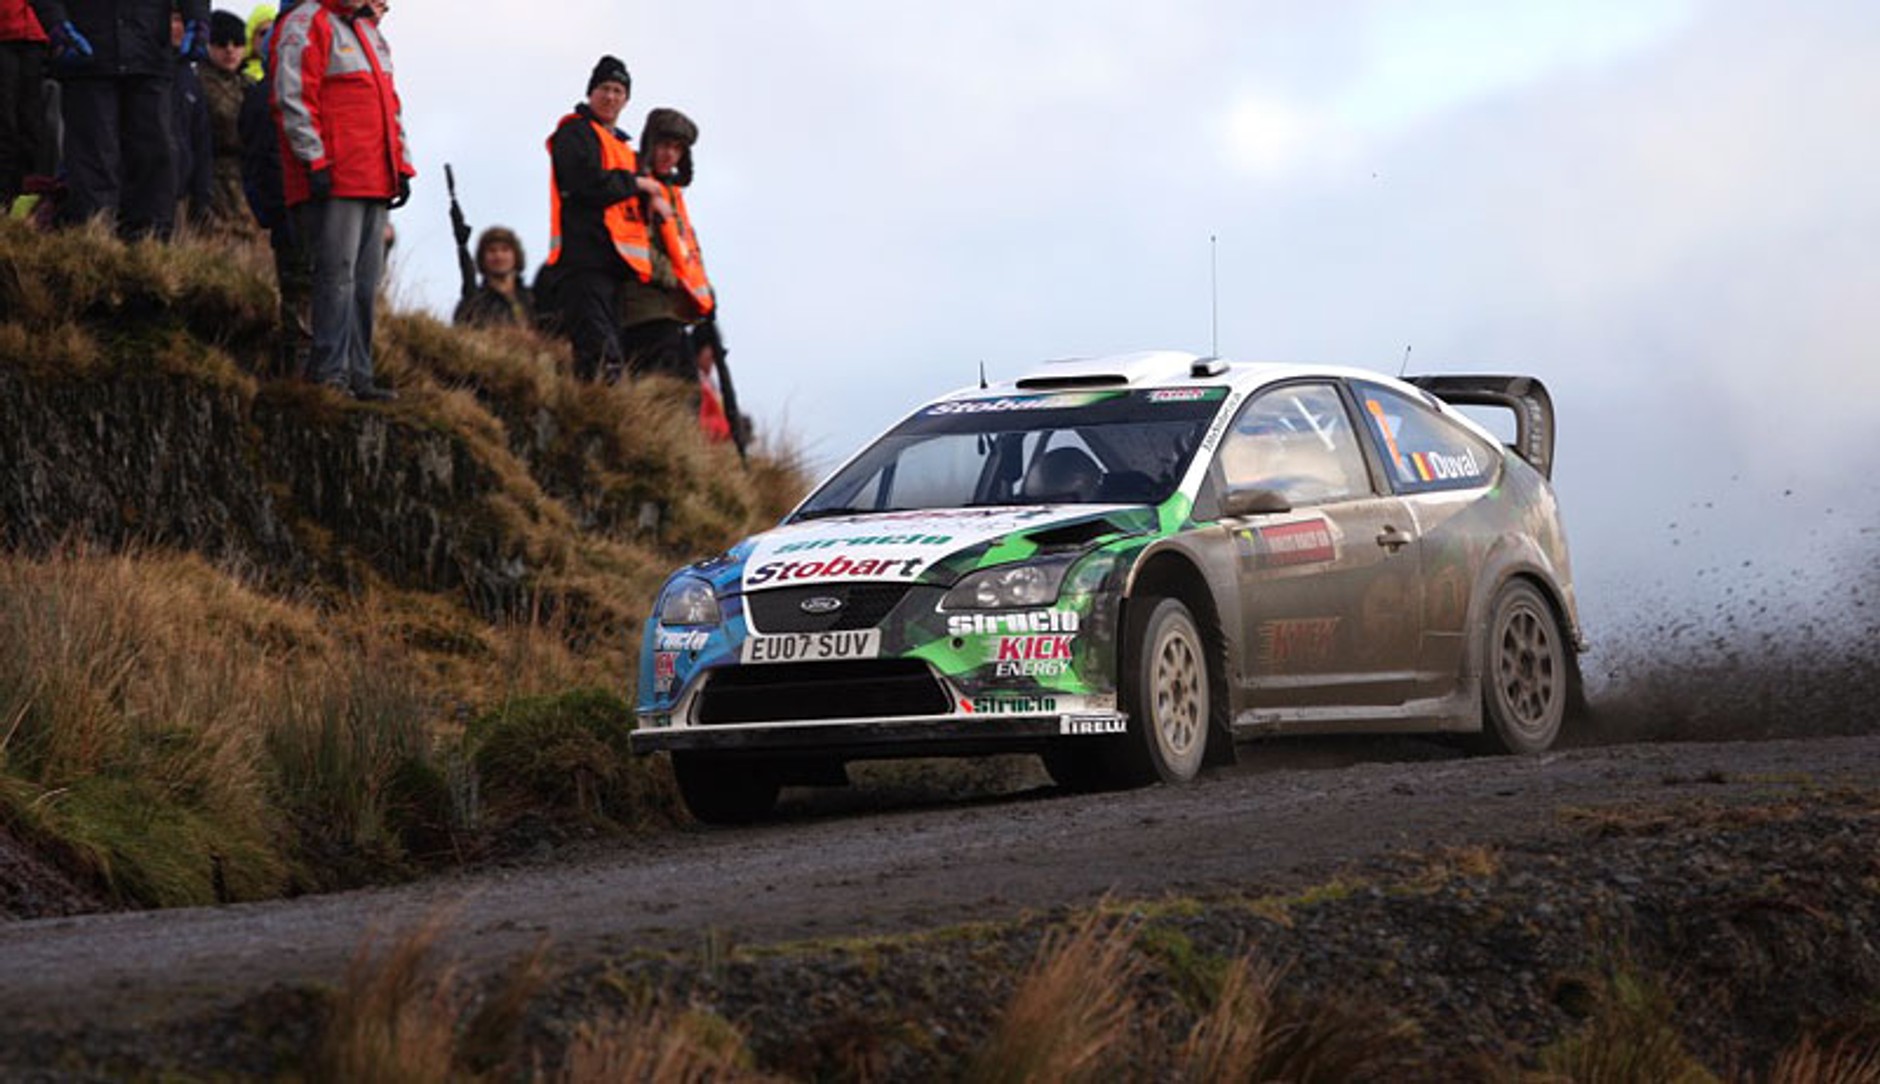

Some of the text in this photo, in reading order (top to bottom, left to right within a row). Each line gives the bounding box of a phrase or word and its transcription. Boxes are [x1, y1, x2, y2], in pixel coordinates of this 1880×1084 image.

[1428, 447, 1480, 479] Duval
[746, 555, 923, 585] Stobart
[751, 632, 870, 661] EU07 SUV
[997, 635, 1076, 660] KICK
[996, 660, 1069, 677] ENERGY
